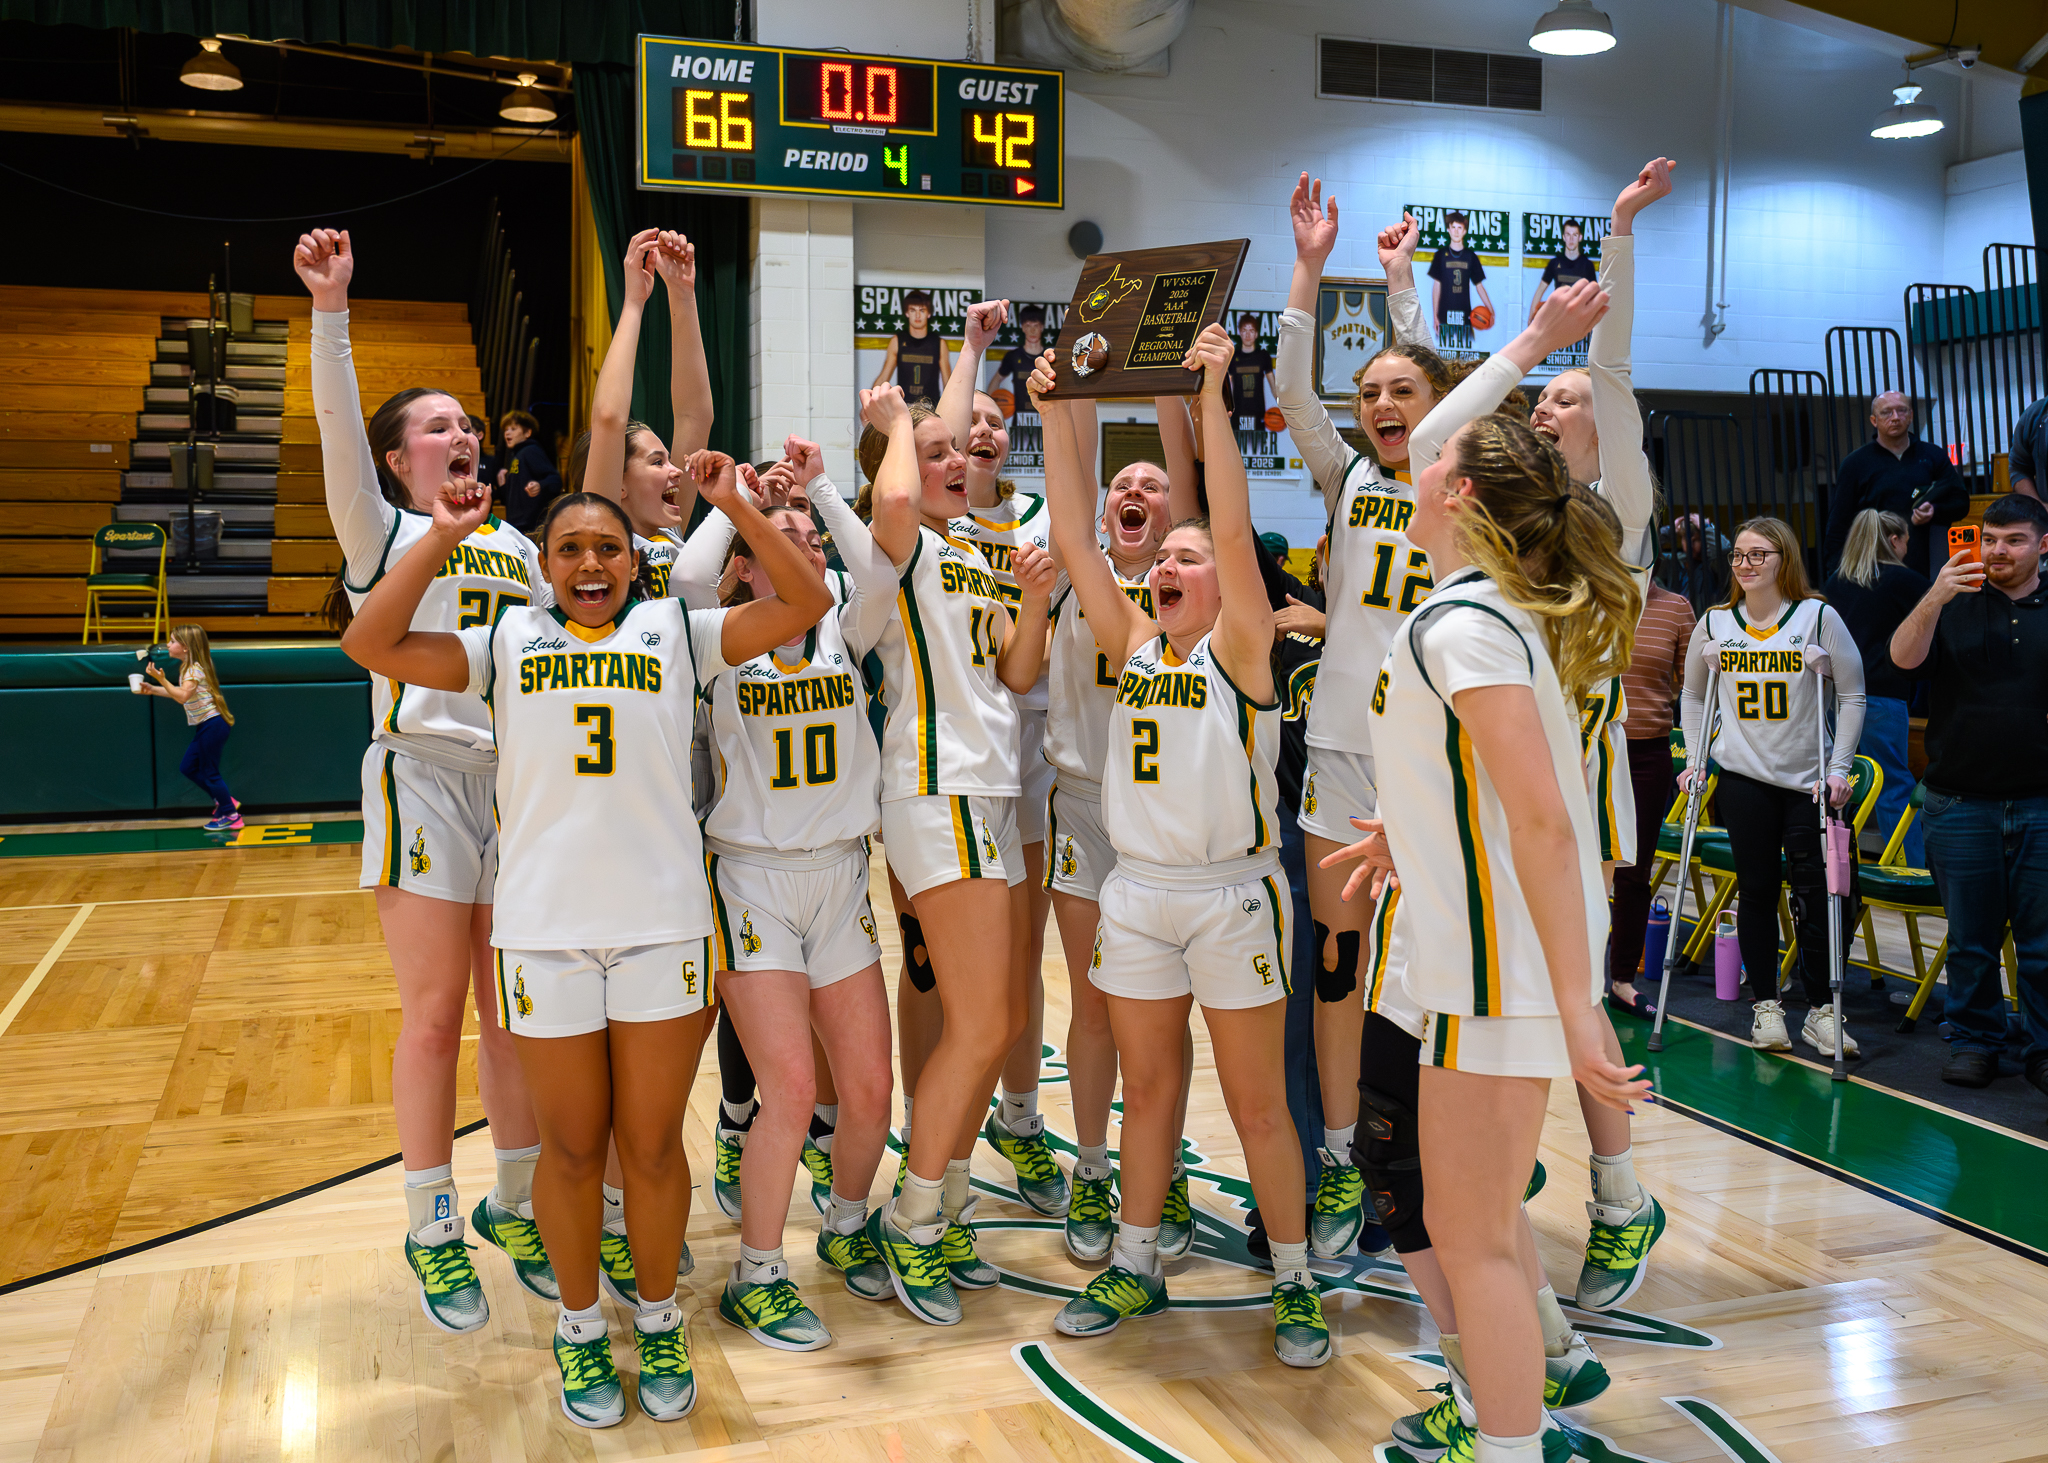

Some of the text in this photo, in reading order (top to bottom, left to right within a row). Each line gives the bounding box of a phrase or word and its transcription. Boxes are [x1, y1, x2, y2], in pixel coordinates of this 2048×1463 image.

[671, 54, 755, 84] HOME
[821, 62, 897, 123] 0.0
[958, 77, 1039, 105] GUEST
[685, 89, 753, 151] 66
[973, 112, 1035, 169] 42
[784, 148, 869, 173] PERIOD
[884, 144, 908, 186] 4
[1412, 205, 1502, 236] SPAANS
[1163, 275, 1206, 288] WVSSAC
[861, 287, 972, 318] SPAANS
[1169, 289, 1190, 300] 2026
[1143, 311, 1198, 326] BASKETBALL
[1331, 323, 1377, 342] SPARTANS
[1343, 336, 1365, 351] 44
[1438, 325, 1472, 349] NEAL
[1133, 351, 1184, 363] CHAMPION
[1138, 340, 1184, 352] REGIONAL
[1546, 354, 1588, 366] SENIOR 202
[1252, 457, 1274, 468] 2026
[1358, 480, 1400, 495] Lady
[104, 529, 155, 543] Spartans
[948, 520, 980, 536] Lady
[1360, 541, 1436, 615] 12
[522, 637, 568, 653] Lady
[1719, 639, 1749, 650] Lady
[520, 652, 662, 695] SPARTANS
[739, 664, 782, 681] Lady
[1129, 655, 1156, 676] Lady
[1720, 650, 1803, 674] SPARTANS
[737, 673, 856, 717] SPARTANS
[1736, 680, 1790, 722] 20
[574, 703, 617, 777] 3
[1131, 717, 1160, 784] 2
[770, 721, 838, 790] 10
